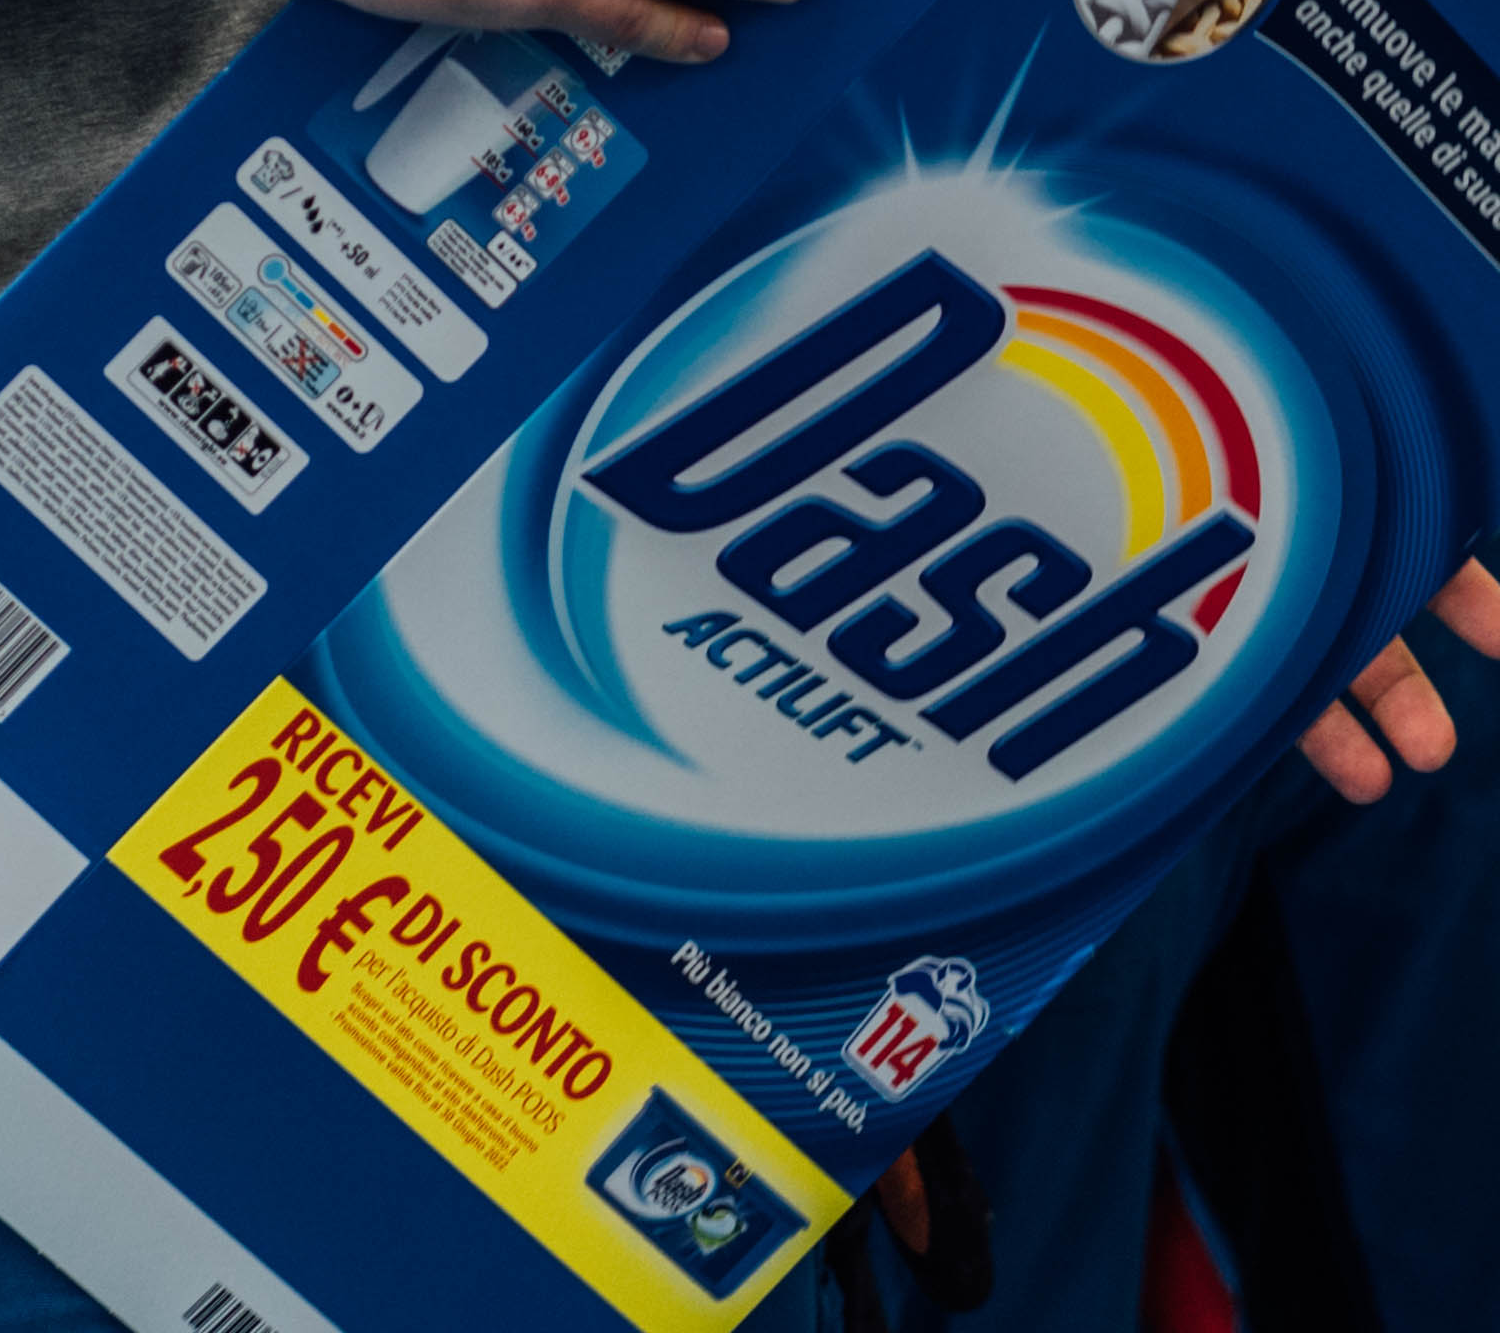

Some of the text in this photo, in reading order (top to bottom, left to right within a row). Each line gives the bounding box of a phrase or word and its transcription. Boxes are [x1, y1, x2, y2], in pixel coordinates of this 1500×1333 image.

[1295, 0, 1367, 76] anche
[1362, 70, 1436, 149] quelle
[1431, 142, 1467, 175] di
[1431, 72, 1463, 116] le
[581, 248, 1256, 783] Dash
[270, 707, 424, 852] RICEVI
[158, 757, 612, 1101] 2,50 € DI SCONTO
[333, 1011, 387, 1064] Promozione
[386, 1060, 414, 1087] valida
[412, 1081, 432, 1103] fino
[440, 1107, 455, 1122] 30
[451, 1118, 486, 1151] Giugno
[347, 1002, 379, 1033] sconto
[377, 1030, 435, 1082] collegandosi
[442, 1087, 461, 1106] sito
[351, 980, 384, 1013] Scopri
[380, 1009, 399, 1026] sul
[394, 1020, 414, 1041] lato
[412, 1038, 439, 1064] come
[437, 1060, 475, 1096] ricevere
[480, 1099, 503, 1121] casa
[508, 1122, 539, 1153] buono
[352, 949, 565, 1133] per l'acquisto di Dash PODS
[670, 939, 710, 984] Più
[704, 968, 772, 1041] bianco
[767, 1032, 812, 1078] non
[818, 1086, 868, 1133] può.
[854, 1001, 939, 1089] 114
